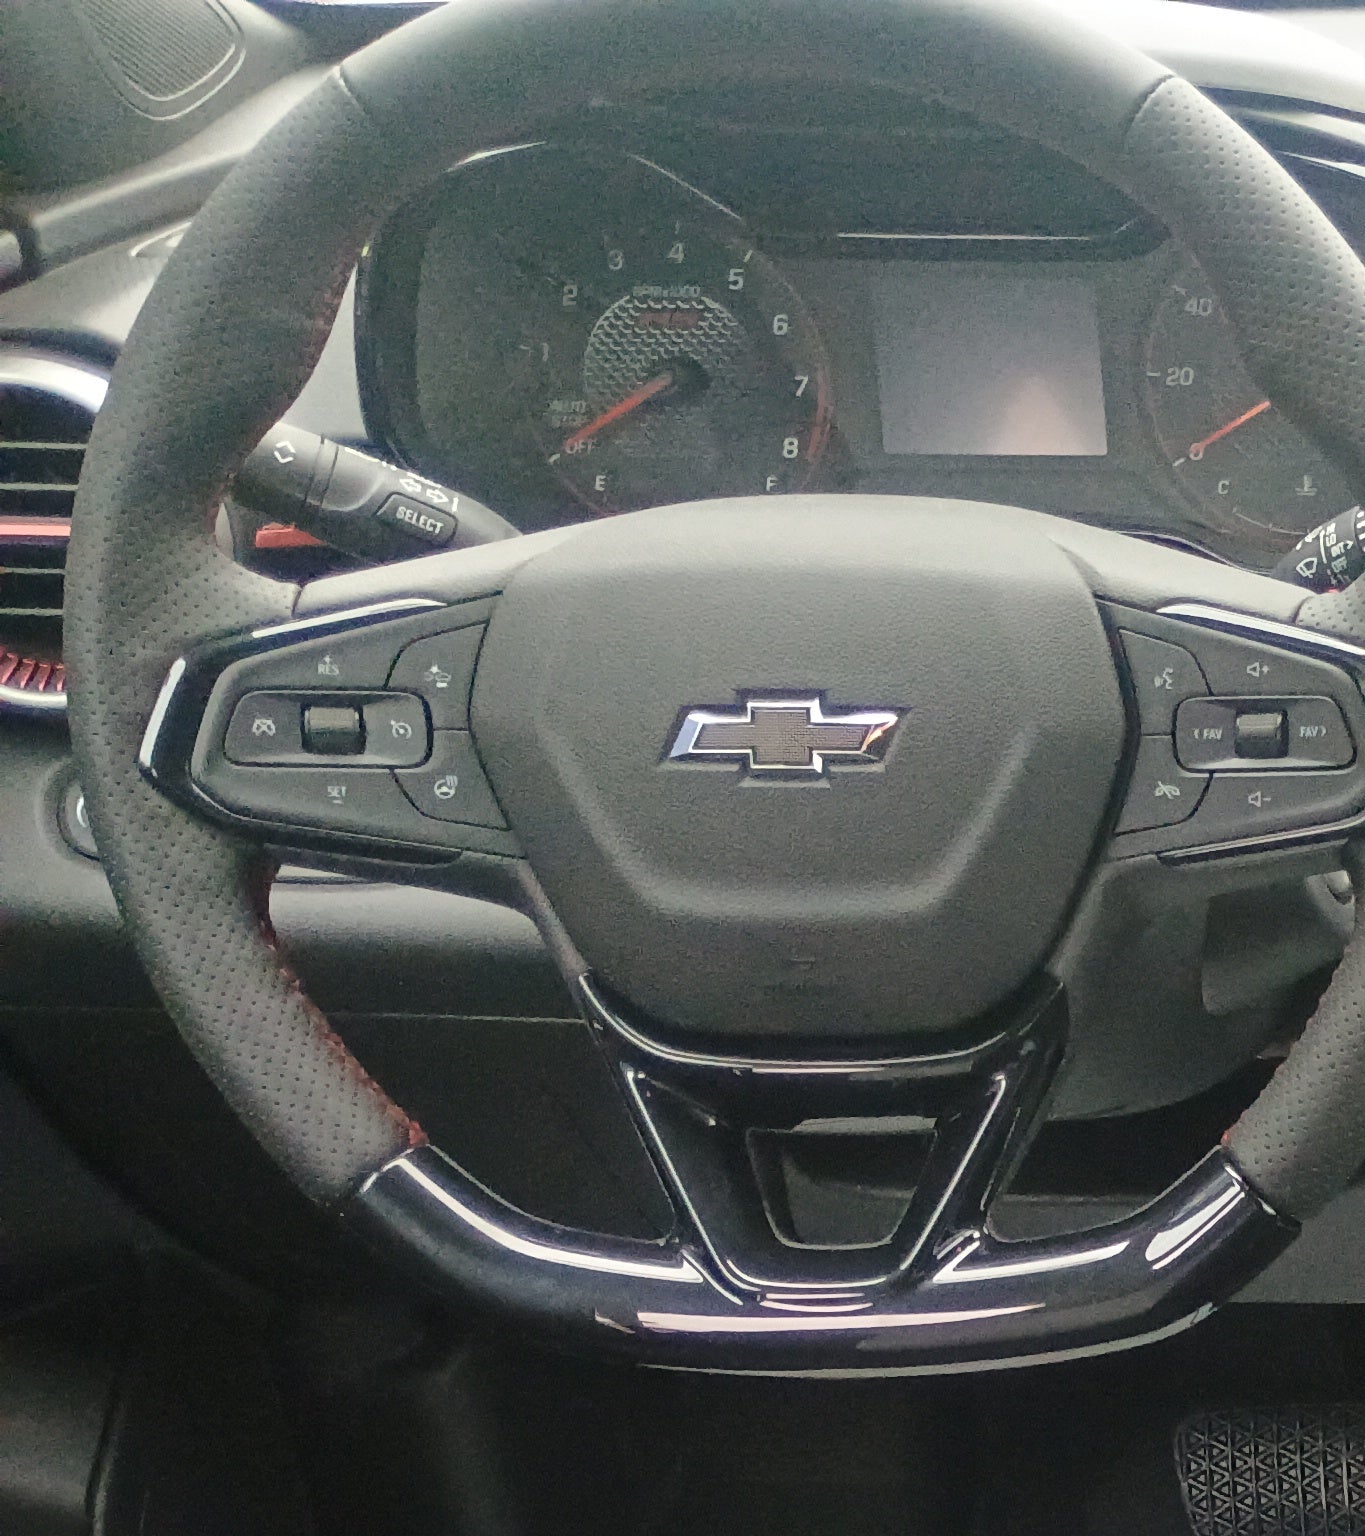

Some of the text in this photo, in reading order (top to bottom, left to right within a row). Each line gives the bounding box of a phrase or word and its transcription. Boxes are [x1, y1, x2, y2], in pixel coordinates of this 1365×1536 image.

[607, 250, 624, 271] 3
[667, 242, 685, 263] 4
[728, 268, 744, 290] 5
[562, 284, 578, 307] 2
[1185, 298, 1213, 317] 40
[772, 314, 789, 335] 6
[794, 375, 809, 397] 7
[1165, 367, 1195, 386] 20
[783, 437, 799, 458] 8
[595, 474, 607, 491] E
[766, 475, 778, 491] F
[1218, 480, 1230, 495] C
[396, 506, 445, 535] SELECT
[317, 663, 340, 676] RES
[1203, 728, 1223, 740] FAV
[1300, 726, 1320, 738] FAV
[326, 785, 347, 798] SET
